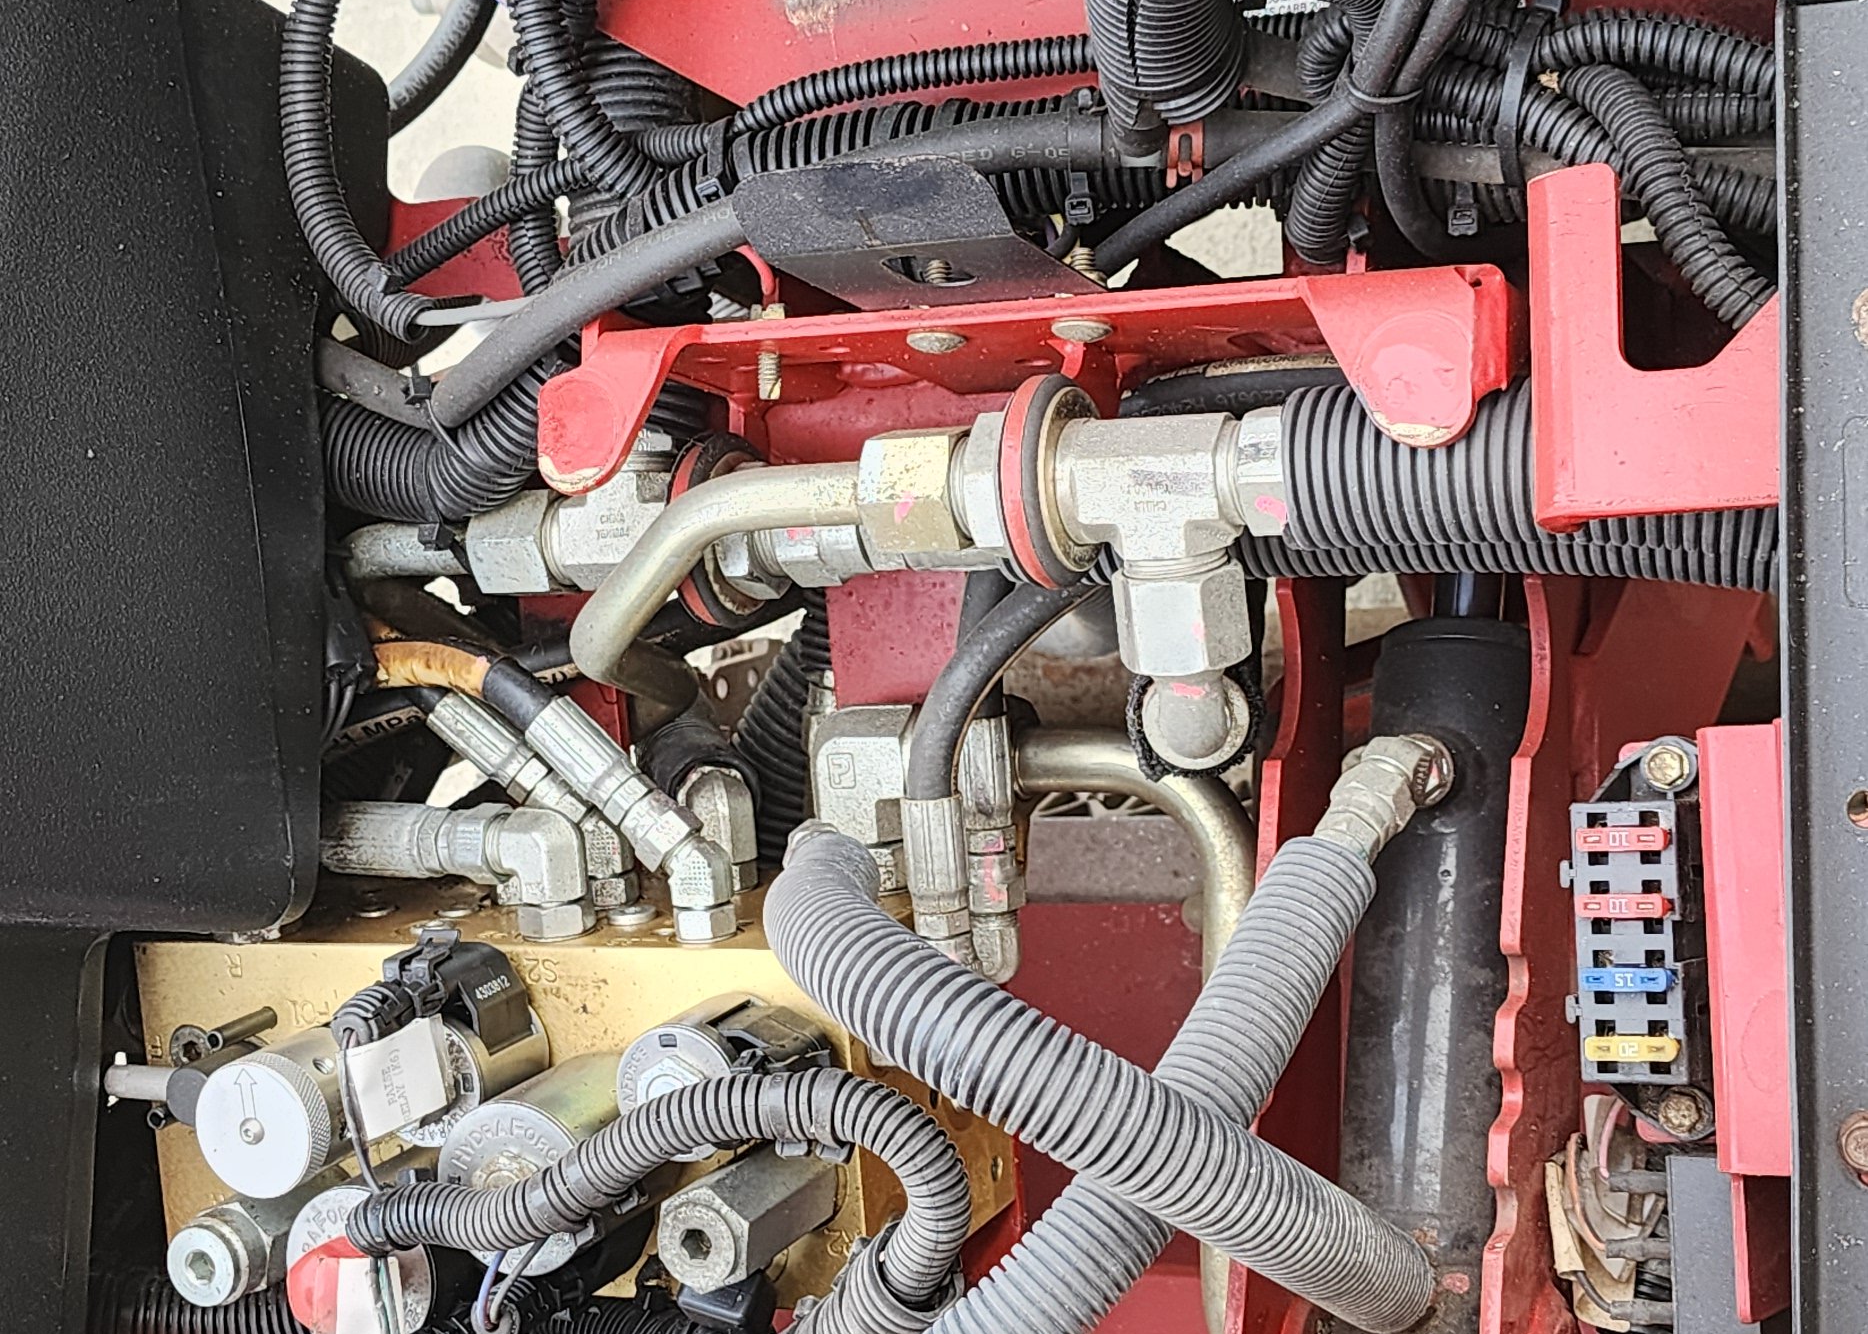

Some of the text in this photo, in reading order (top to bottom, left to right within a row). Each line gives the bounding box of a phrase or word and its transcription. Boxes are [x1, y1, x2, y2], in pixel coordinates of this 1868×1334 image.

[1608, 830, 1630, 847] 10
[1608, 897, 1630, 914] 10
[523, 957, 560, 983] S2
[1614, 971, 1635, 986] 15
[1618, 1042, 1640, 1057] 20
[395, 1084, 414, 1123] RELAY
[450, 1117, 560, 1171] HYDRAFORC
